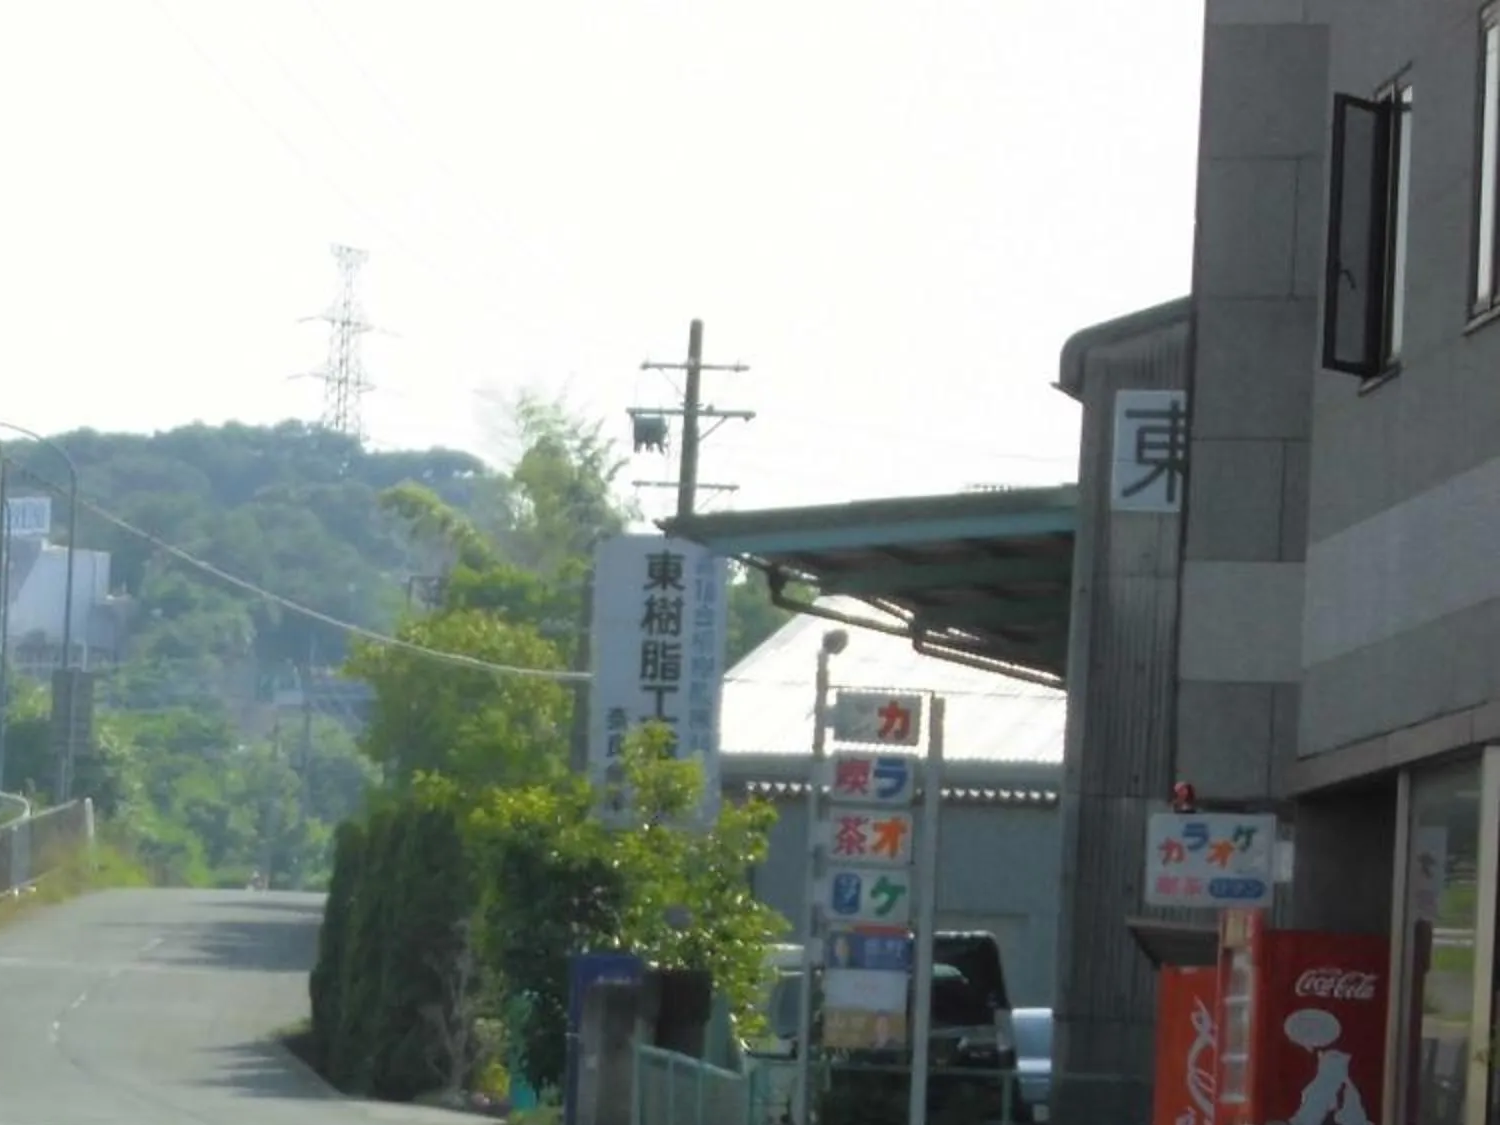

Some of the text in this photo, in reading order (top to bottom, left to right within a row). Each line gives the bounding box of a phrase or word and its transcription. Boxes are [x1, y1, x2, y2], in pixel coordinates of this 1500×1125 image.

[1157, 822, 1259, 869] カラオケ
[1295, 968, 1380, 1001] Coca-Cola
